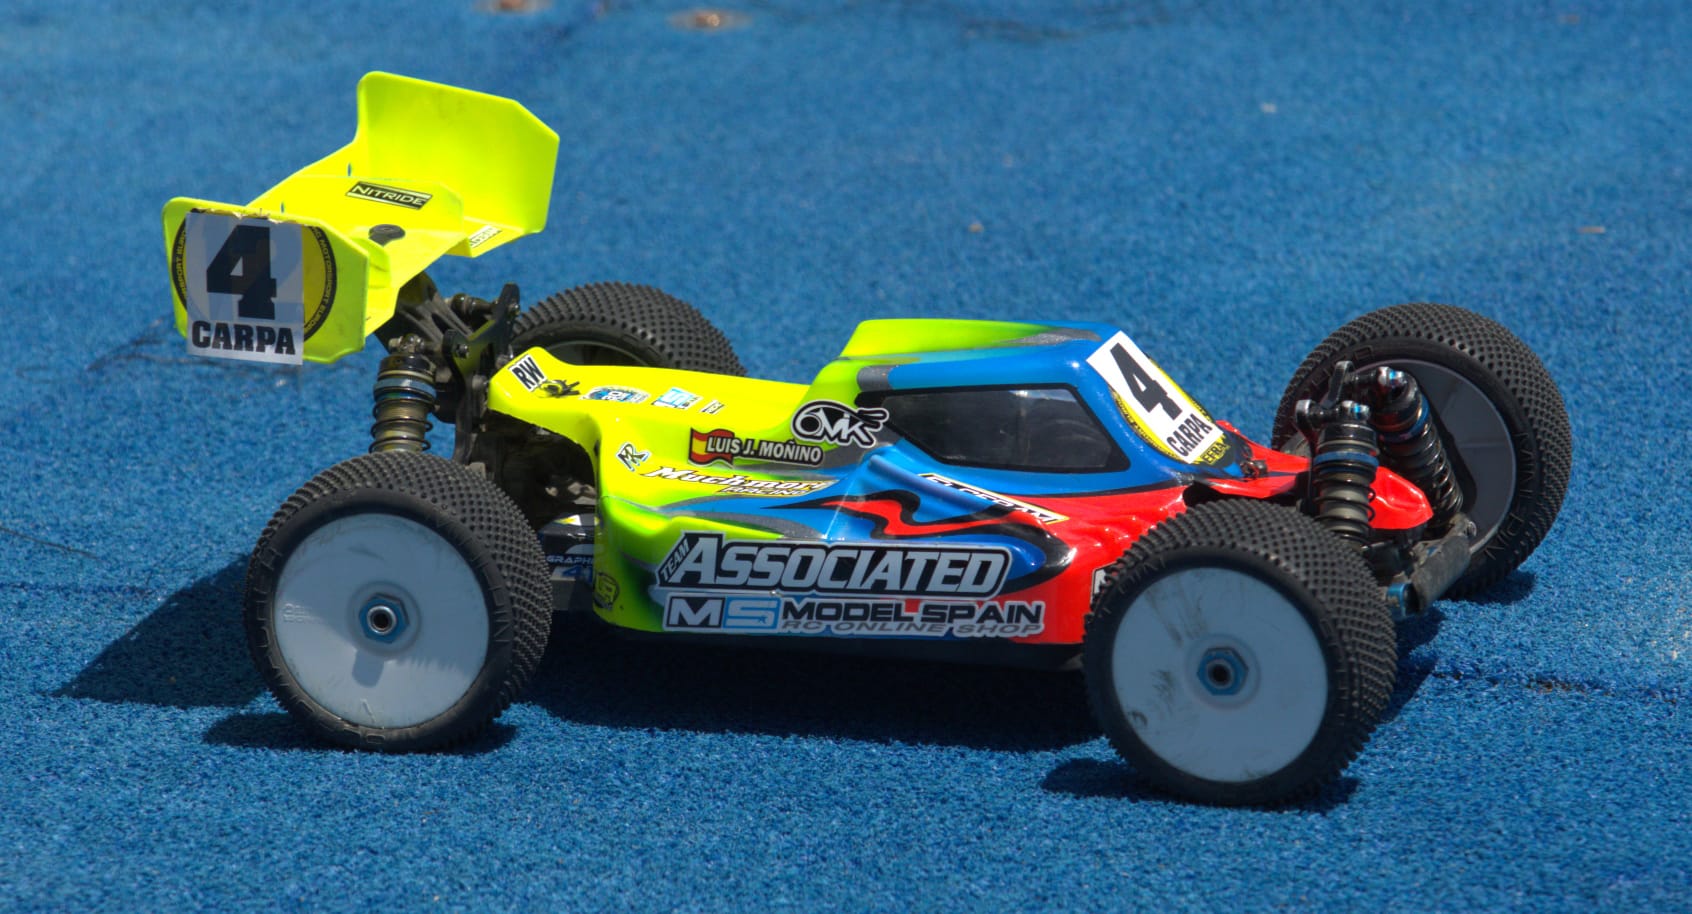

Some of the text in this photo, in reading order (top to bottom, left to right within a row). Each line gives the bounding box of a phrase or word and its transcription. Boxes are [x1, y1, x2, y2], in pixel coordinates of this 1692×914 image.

[351, 184, 427, 206] NITRIDE
[206, 224, 277, 320] 4
[192, 320, 296, 355] CARPA
[511, 355, 545, 390] RW
[1109, 342, 1183, 421] 4
[707, 436, 821, 462] LUIS J. MOÑINO
[1166, 413, 1213, 457] CARPA
[1202, 440, 1228, 463] EFRA
[660, 536, 691, 582] TEAM
[782, 620, 1042, 634] RC ONLINE SHOP
